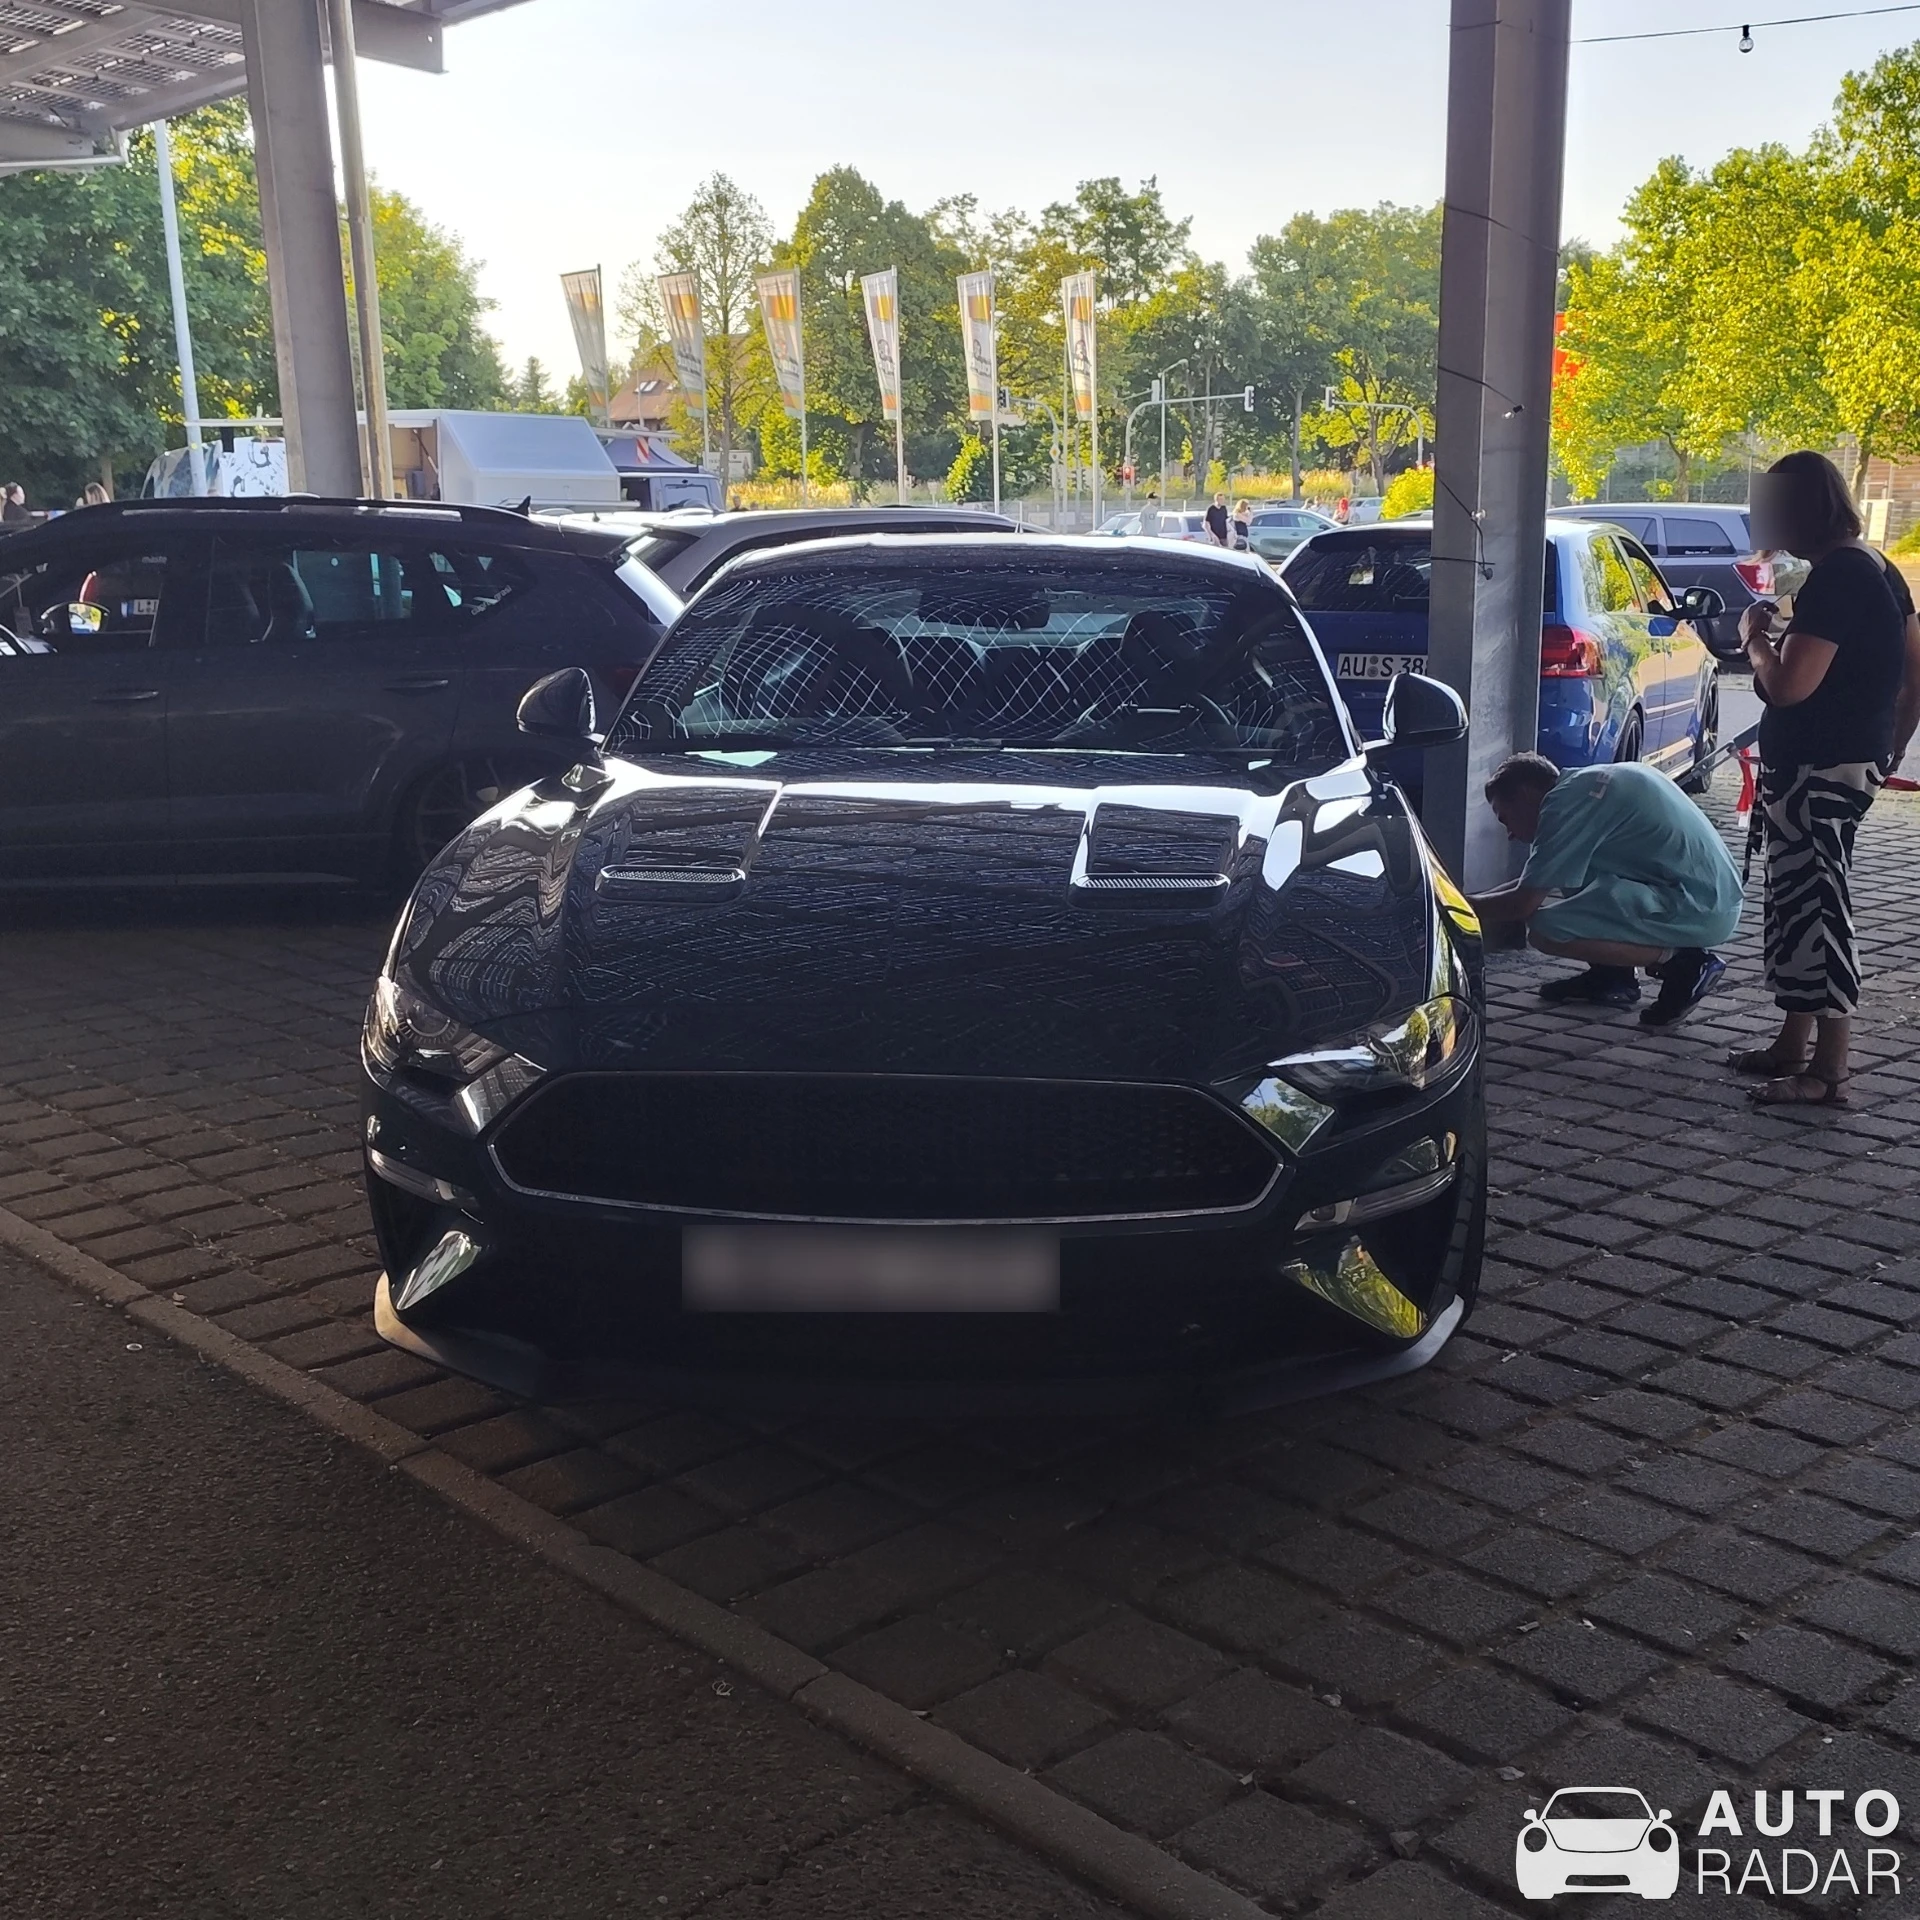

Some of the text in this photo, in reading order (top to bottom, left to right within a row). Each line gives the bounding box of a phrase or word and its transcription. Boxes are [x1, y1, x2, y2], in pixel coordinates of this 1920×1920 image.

[1339, 656, 1428, 677] AU S 38
